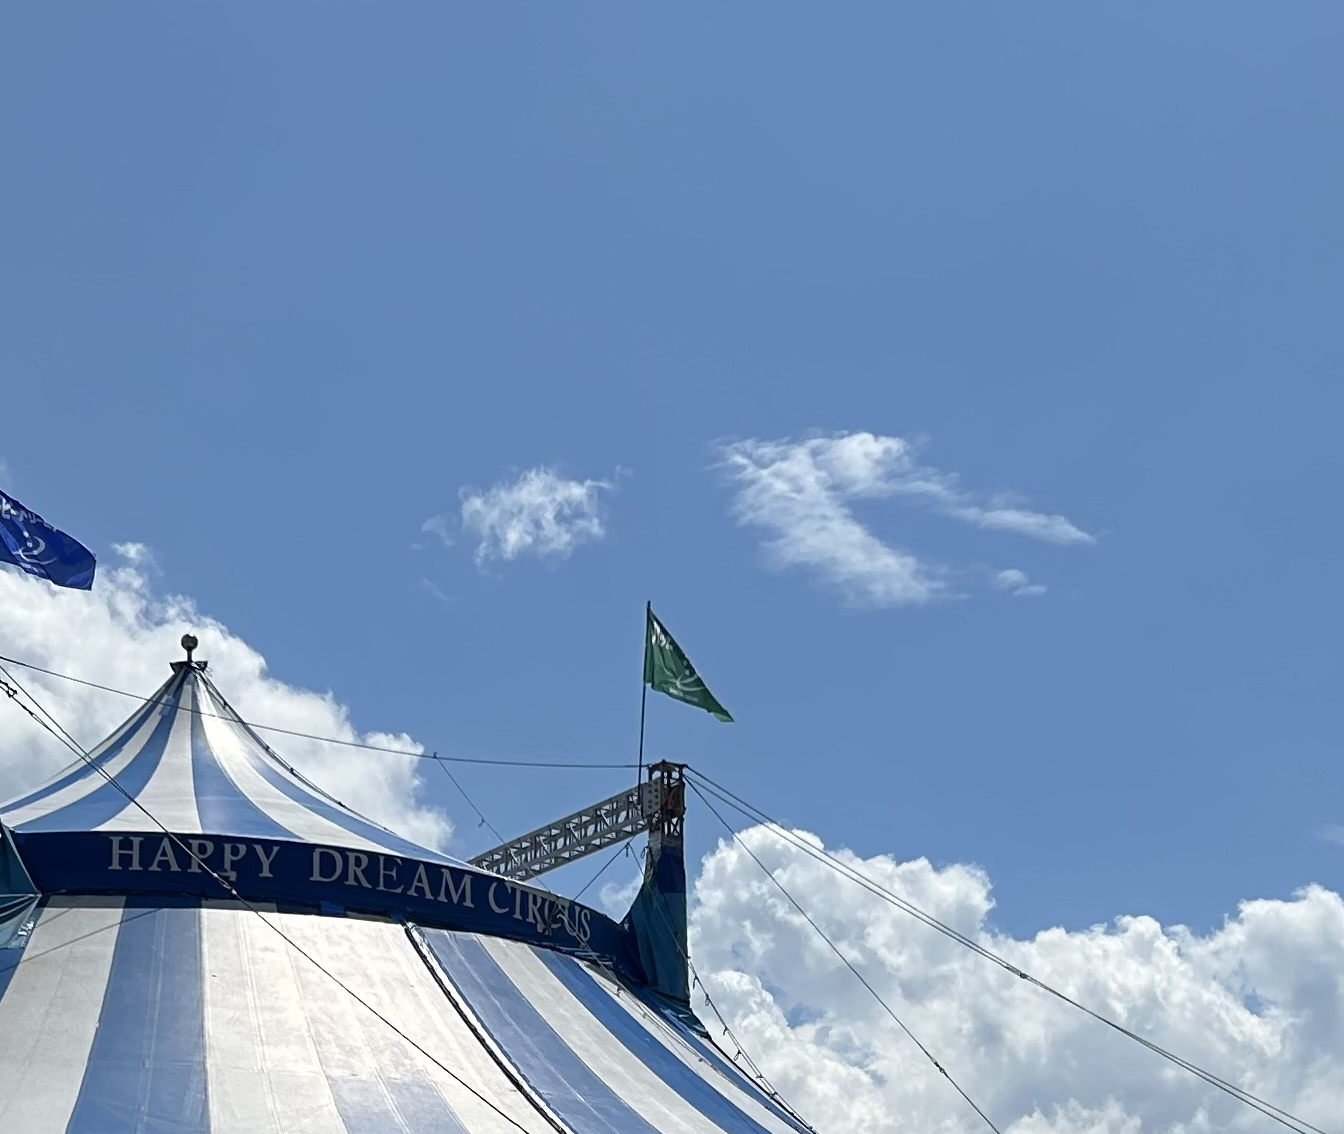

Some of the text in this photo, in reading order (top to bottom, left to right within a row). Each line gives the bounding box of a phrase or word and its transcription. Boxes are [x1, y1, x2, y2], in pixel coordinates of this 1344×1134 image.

[108, 835, 592, 942] HAPPY DREAM CIRCUS
